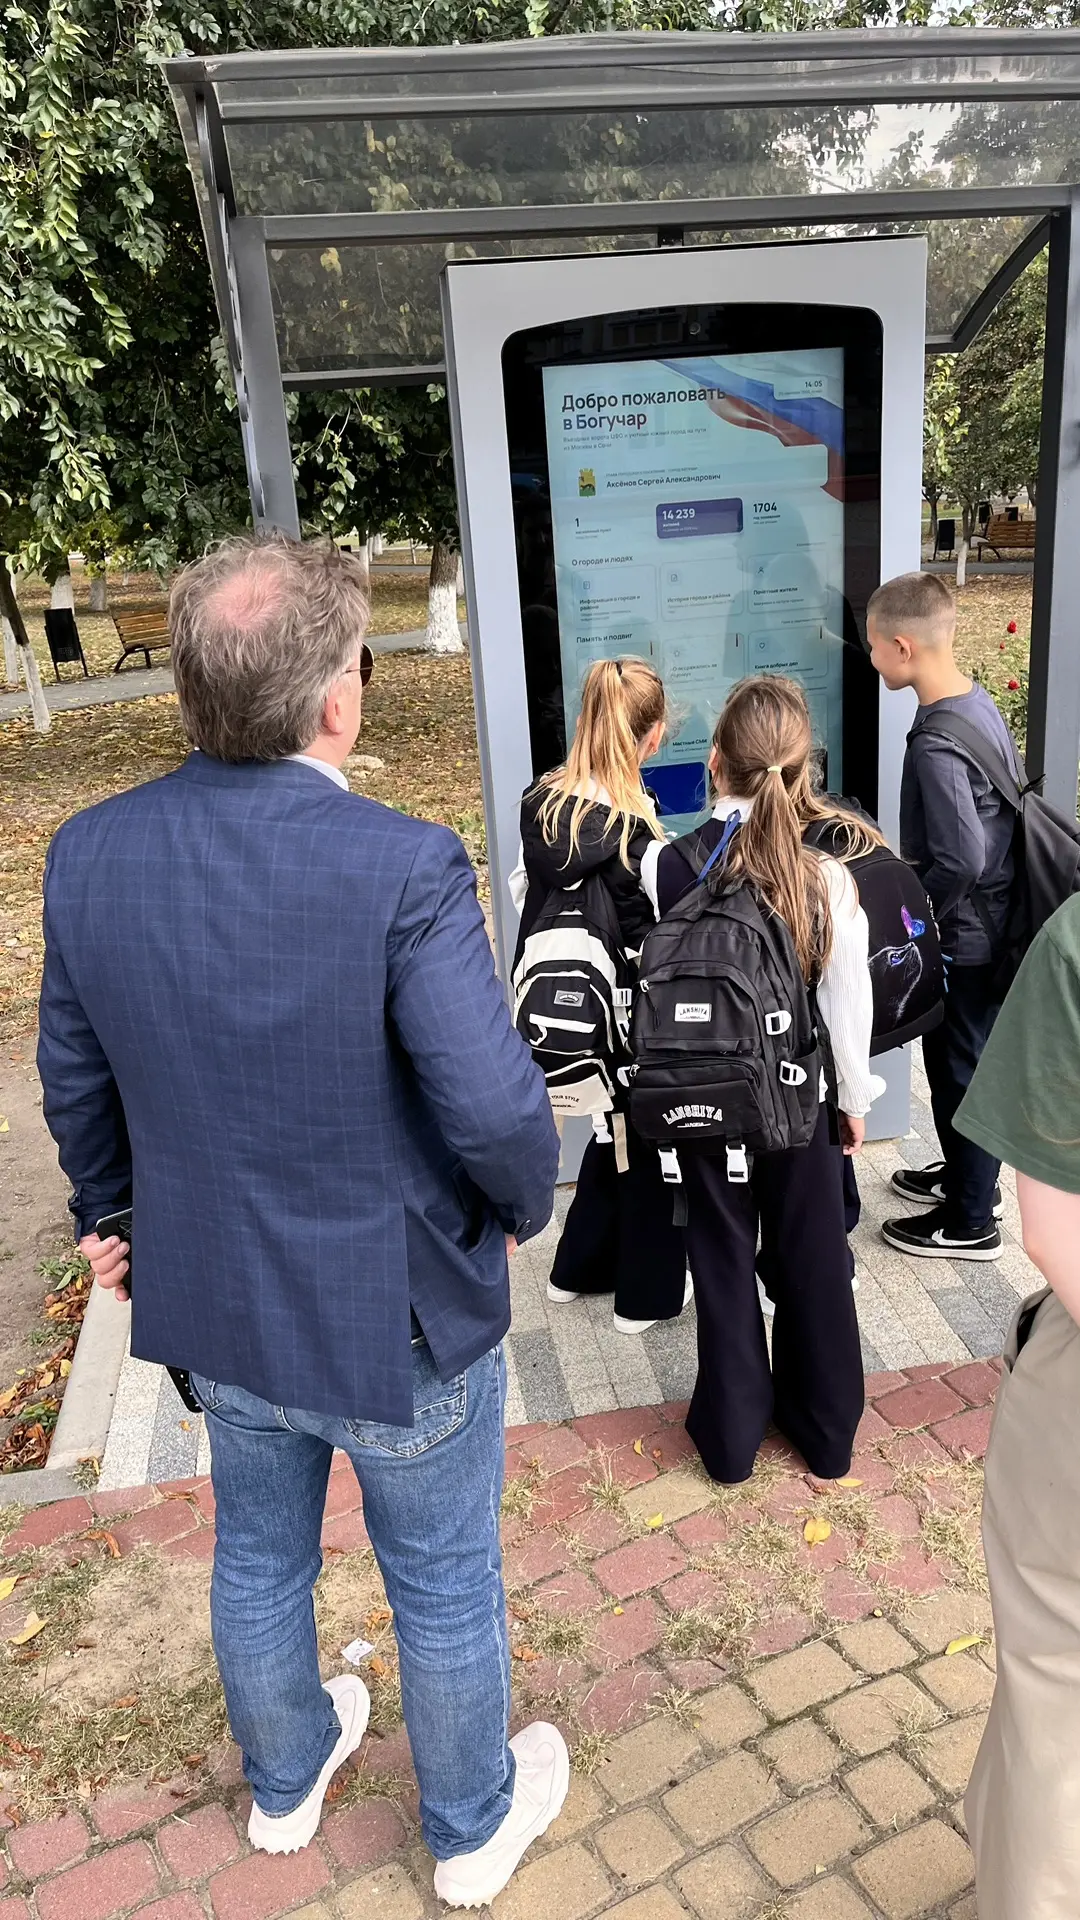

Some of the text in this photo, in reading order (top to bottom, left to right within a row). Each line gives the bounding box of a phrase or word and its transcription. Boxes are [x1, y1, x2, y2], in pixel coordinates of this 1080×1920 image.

[562, 386, 726, 412] Добро пожаловать
[563, 413, 647, 432] в Богучар
[638, 477, 664, 486] Сергей
[665, 474, 721, 483] Александрович
[753, 502, 778, 513] 1704
[575, 517, 580, 527] 1
[579, 557, 604, 566] городе
[611, 555, 634, 563] людях
[577, 635, 602, 643] Память
[609, 632, 633, 640] подвиг
[680, 1007, 707, 1016] LANSHIYA
[565, 1095, 580, 1103] STYLE
[662, 1105, 723, 1125] LANSHIYA
